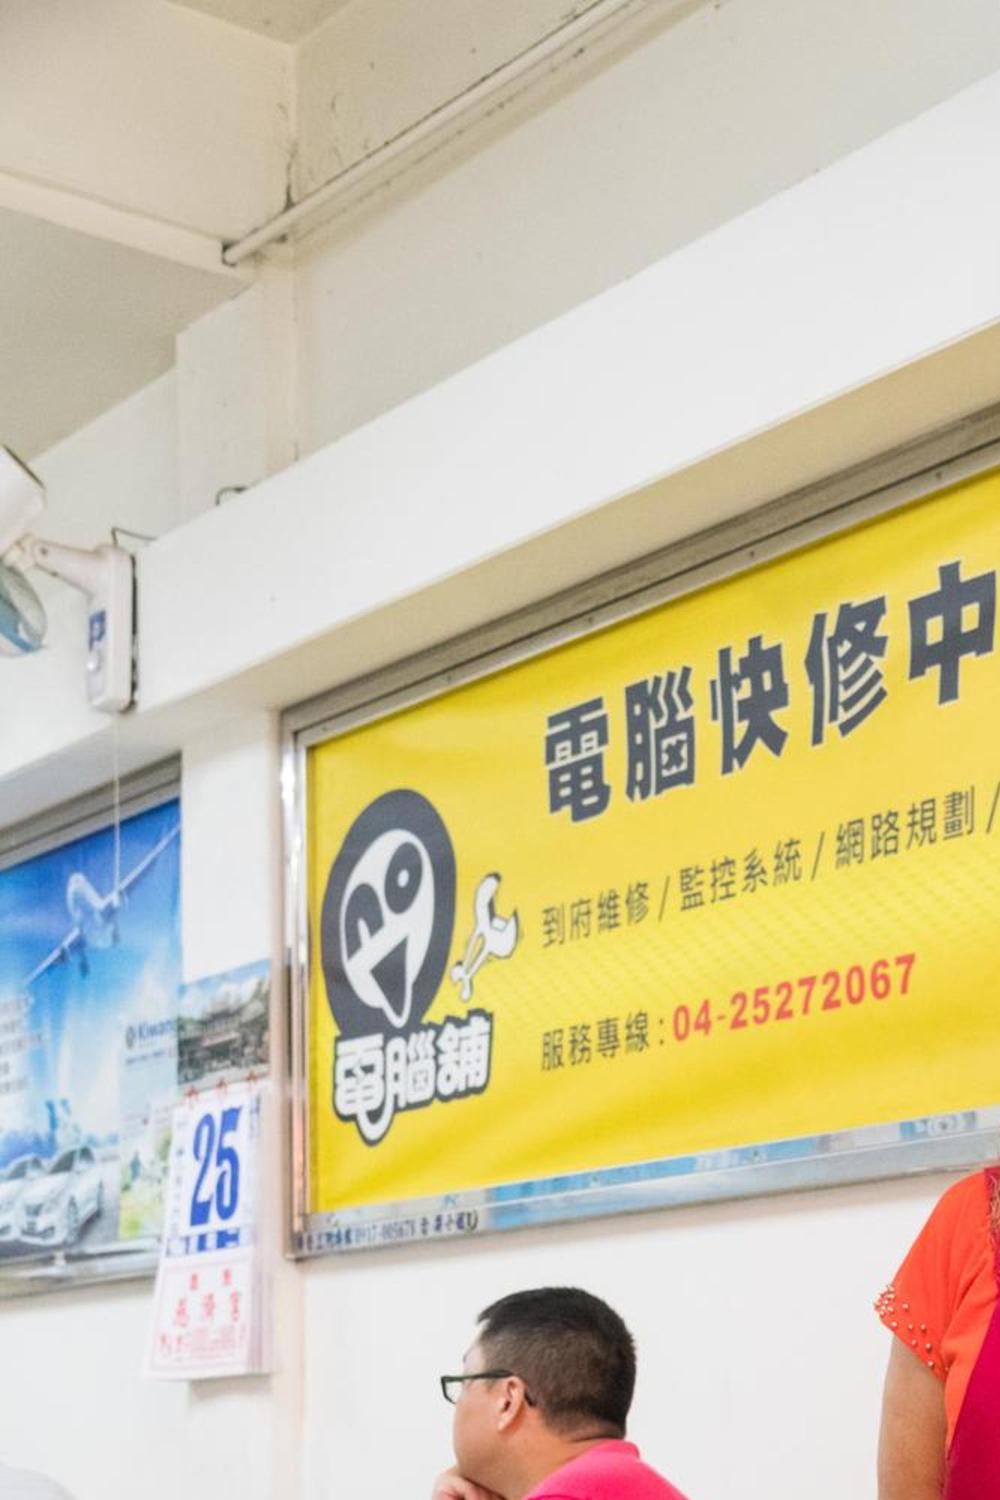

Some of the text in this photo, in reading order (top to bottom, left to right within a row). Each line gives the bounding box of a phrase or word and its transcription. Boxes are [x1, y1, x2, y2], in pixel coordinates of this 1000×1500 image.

[542, 881, 650, 949] 到府維修
[680, 837, 803, 912] 監控系統
[835, 785, 976, 870] 網路規劃
[672, 953, 917, 1043] 04-25272067
[189, 1104, 243, 1228] 25
